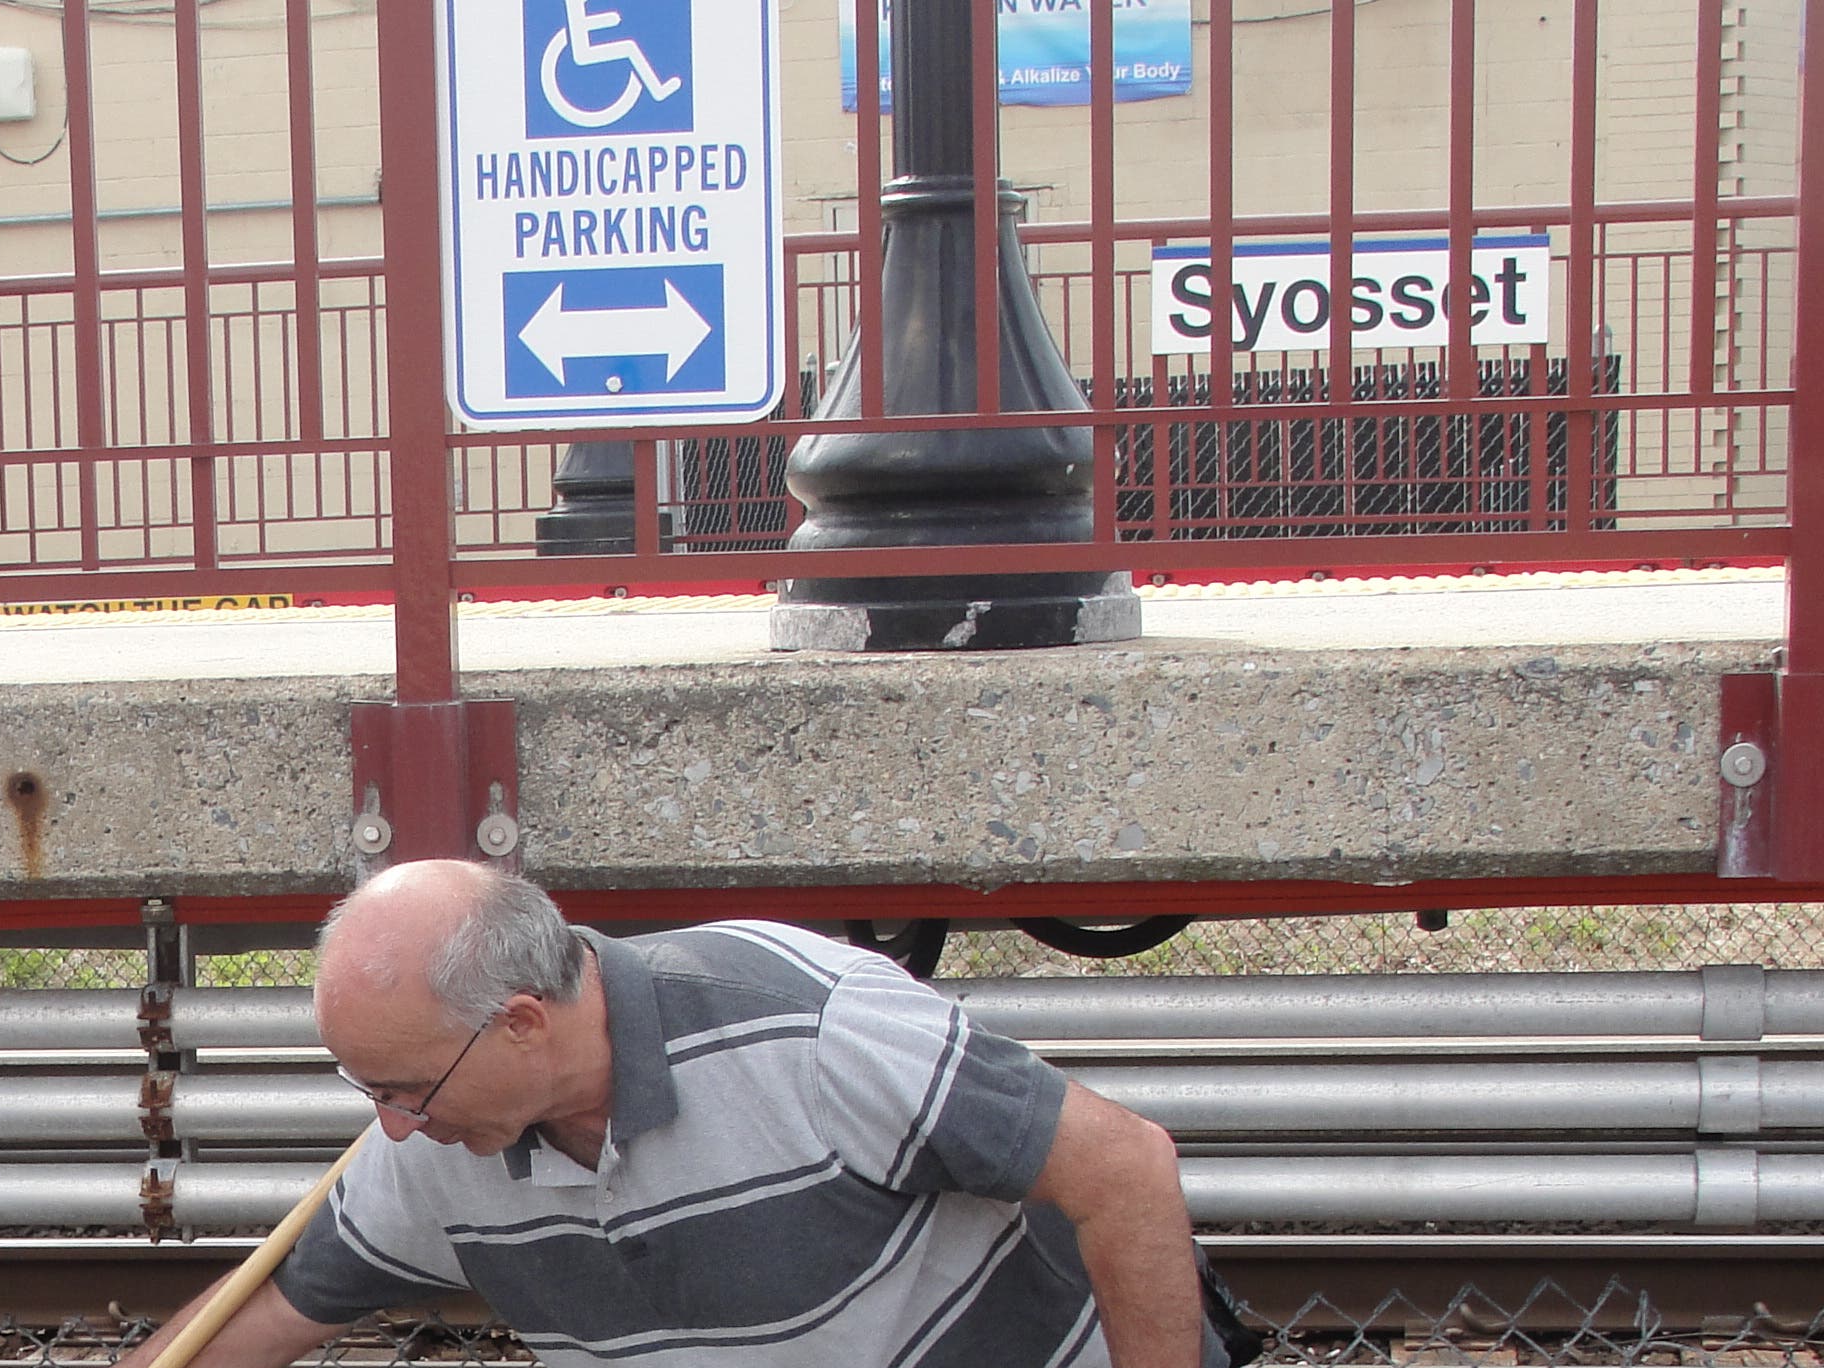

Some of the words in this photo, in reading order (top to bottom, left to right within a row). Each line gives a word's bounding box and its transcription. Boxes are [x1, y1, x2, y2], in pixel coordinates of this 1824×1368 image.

[1011, 67, 1080, 85] Alkalize
[1133, 62, 1180, 81] Body
[476, 144, 748, 200] HANDICAPPED
[515, 205, 709, 258] PARKING
[1169, 257, 1527, 351] Syosset
